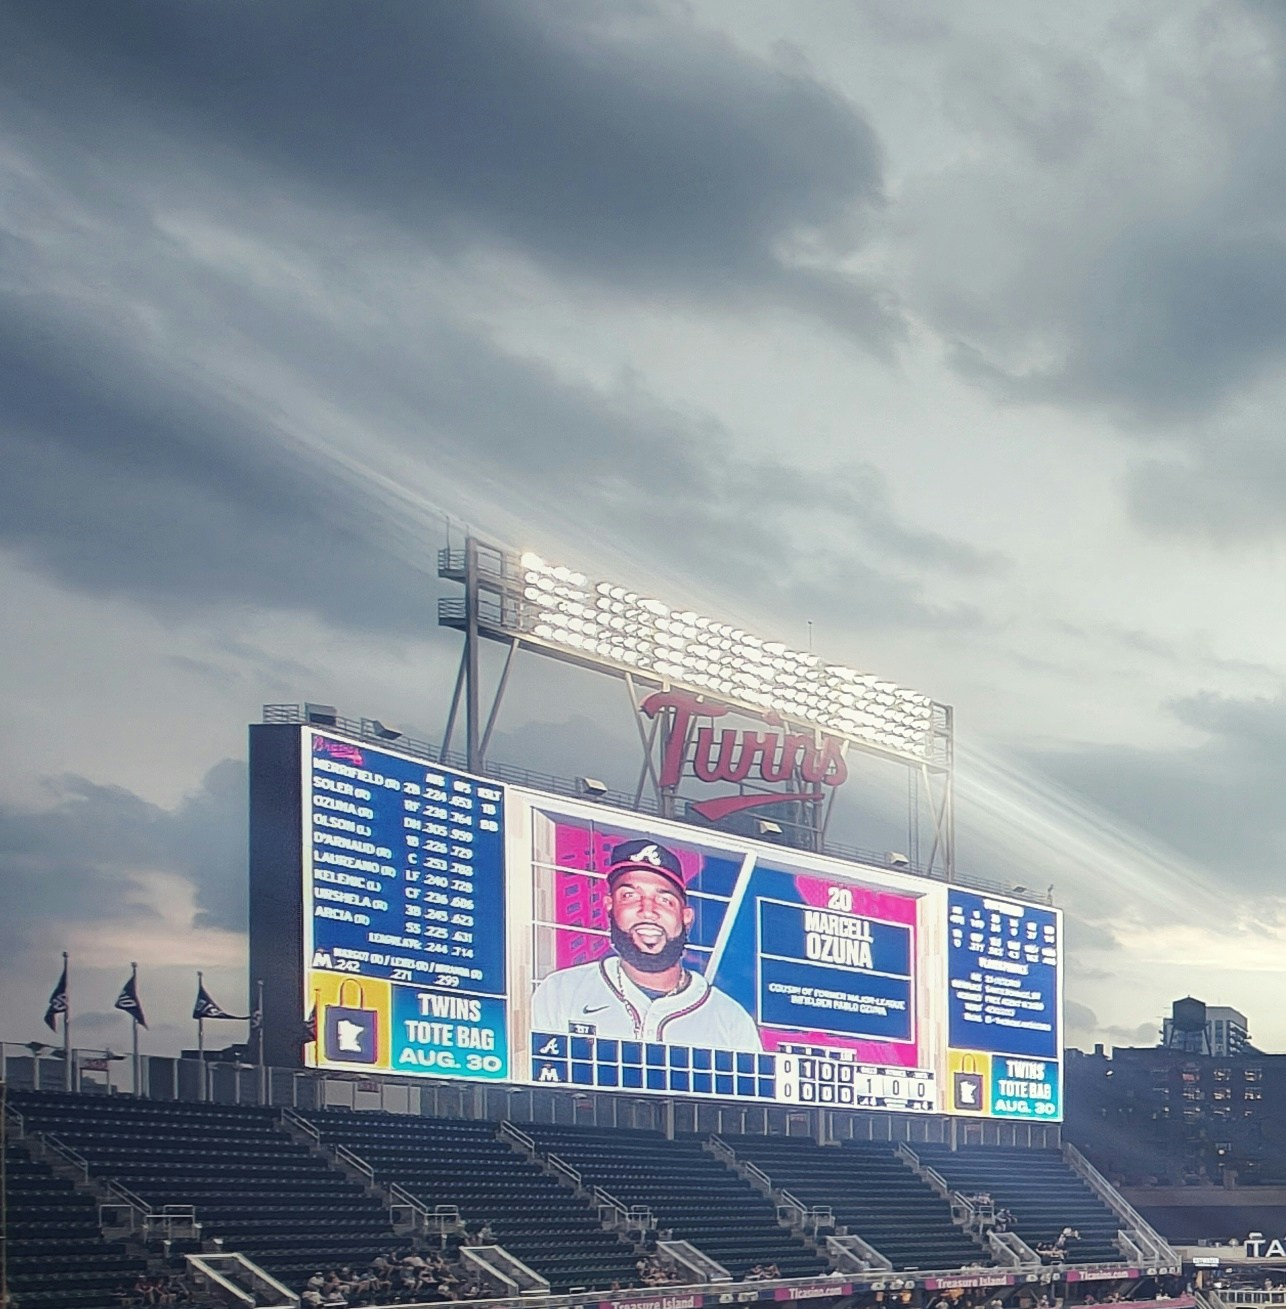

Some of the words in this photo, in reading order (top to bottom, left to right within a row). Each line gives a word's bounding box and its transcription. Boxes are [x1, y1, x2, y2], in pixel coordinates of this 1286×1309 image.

[640, 690, 848, 788] Twins
[313, 813, 356, 833] OLSON
[408, 853, 418, 864] C
[405, 869, 421, 882] LF
[827, 887, 853, 912] 20
[804, 910, 874, 943] MARCELL
[806, 933, 874, 969] OZUNA
[418, 992, 481, 1022] TWINS
[404, 1020, 454, 1047] TOTE
[457, 1026, 495, 1051] BAG
[399, 1047, 462, 1069] AUG.
[466, 1054, 502, 1072] 30
[1005, 1060, 1045, 1080] TWINS
[784, 1060, 792, 1073] 0
[803, 1060, 813, 1079] 1
[822, 1062, 833, 1081] 0
[840, 1065, 852, 1083] 0
[784, 1083, 792, 1097] 0
[803, 1082, 814, 1100] 0
[821, 1084, 833, 1102] 0
[840, 1086, 852, 1103] 0
[866, 1078, 873, 1094] 1
[892, 1080, 900, 1095] 0
[917, 1083, 926, 1098] 0
[998, 1080, 1028, 1098] TOTE
[994, 1099, 1032, 1113] AUG.
[1034, 1102, 1056, 1115] 30
[979, 1273, 1008, 1287] Island
